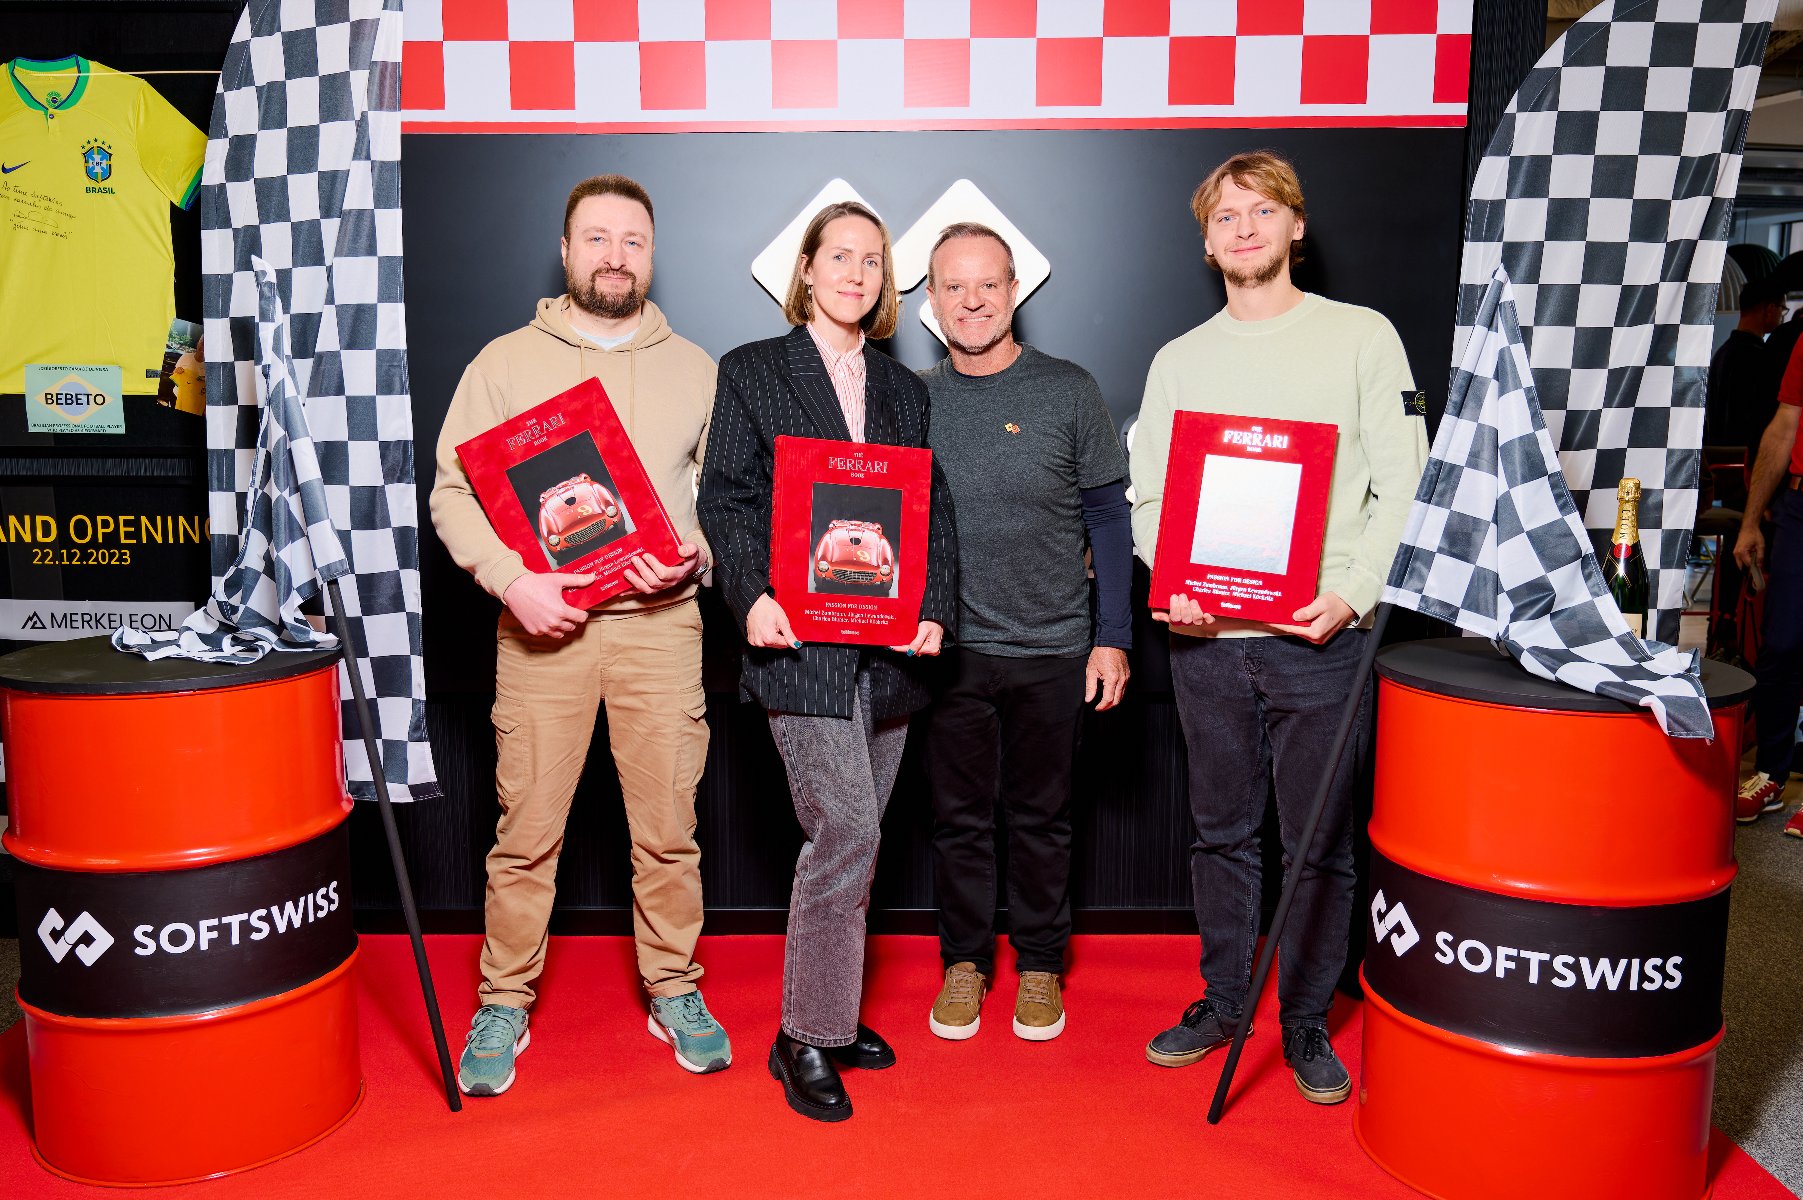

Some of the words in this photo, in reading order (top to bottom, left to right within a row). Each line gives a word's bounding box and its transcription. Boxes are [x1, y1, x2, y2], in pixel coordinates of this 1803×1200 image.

[85, 186, 116, 195] BRASIL
[44, 392, 106, 406] BEBETO
[506, 412, 566, 451] FERRARI
[1223, 429, 1289, 449] FERRARI
[828, 456, 889, 474] FERRARI
[32, 548, 131, 566] 22.12.2023
[133, 880, 340, 957] SOFTSWISS
[1434, 930, 1683, 992] SOFTSWISS
